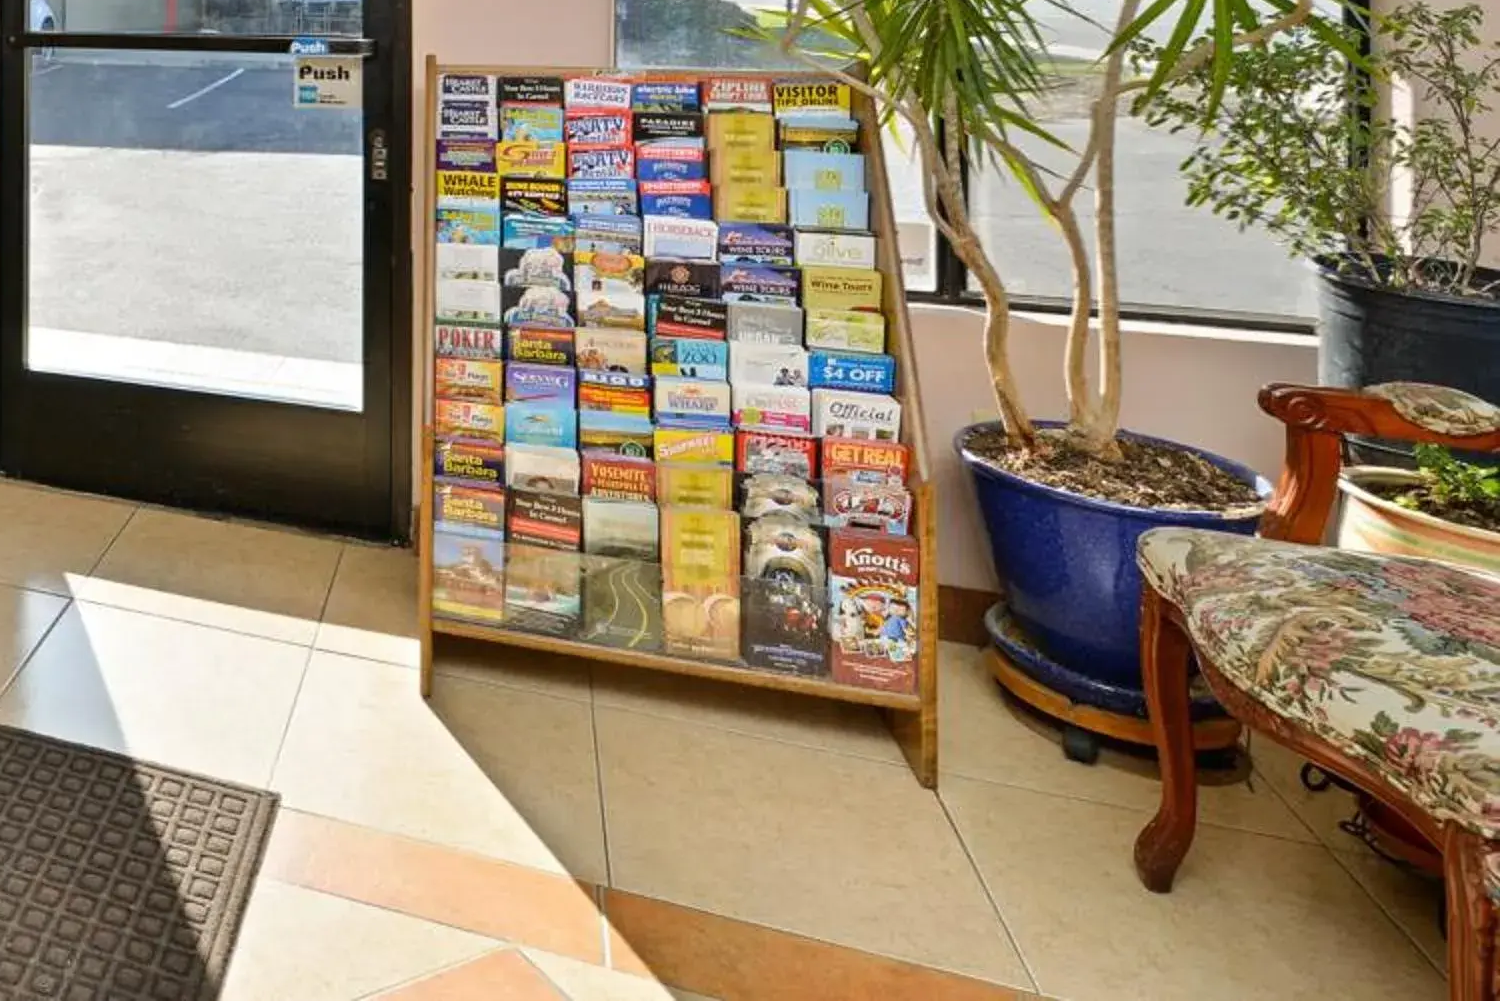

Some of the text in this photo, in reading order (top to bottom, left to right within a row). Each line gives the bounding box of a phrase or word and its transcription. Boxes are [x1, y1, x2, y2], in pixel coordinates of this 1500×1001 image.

[290, 40, 326, 55] Push
[299, 64, 351, 81] Push
[775, 85, 839, 98] VISITOR
[776, 98, 838, 107] TIPS ONLINE
[443, 174, 497, 188] WHALE
[444, 186, 494, 199] Watching
[811, 280, 874, 292] Wine Tours
[439, 327, 495, 349] POKER
[514, 348, 567, 360] Barbara
[823, 365, 886, 382] $4 OFF
[828, 401, 894, 422] Official
[443, 451, 484, 466] Santa
[831, 443, 903, 466] GET REAL
[443, 463, 498, 479] Barbara
[591, 462, 647, 482] YOSEMITE
[443, 494, 484, 509] Santa
[443, 506, 498, 522] Barbara
[844, 547, 912, 574] Knott's
